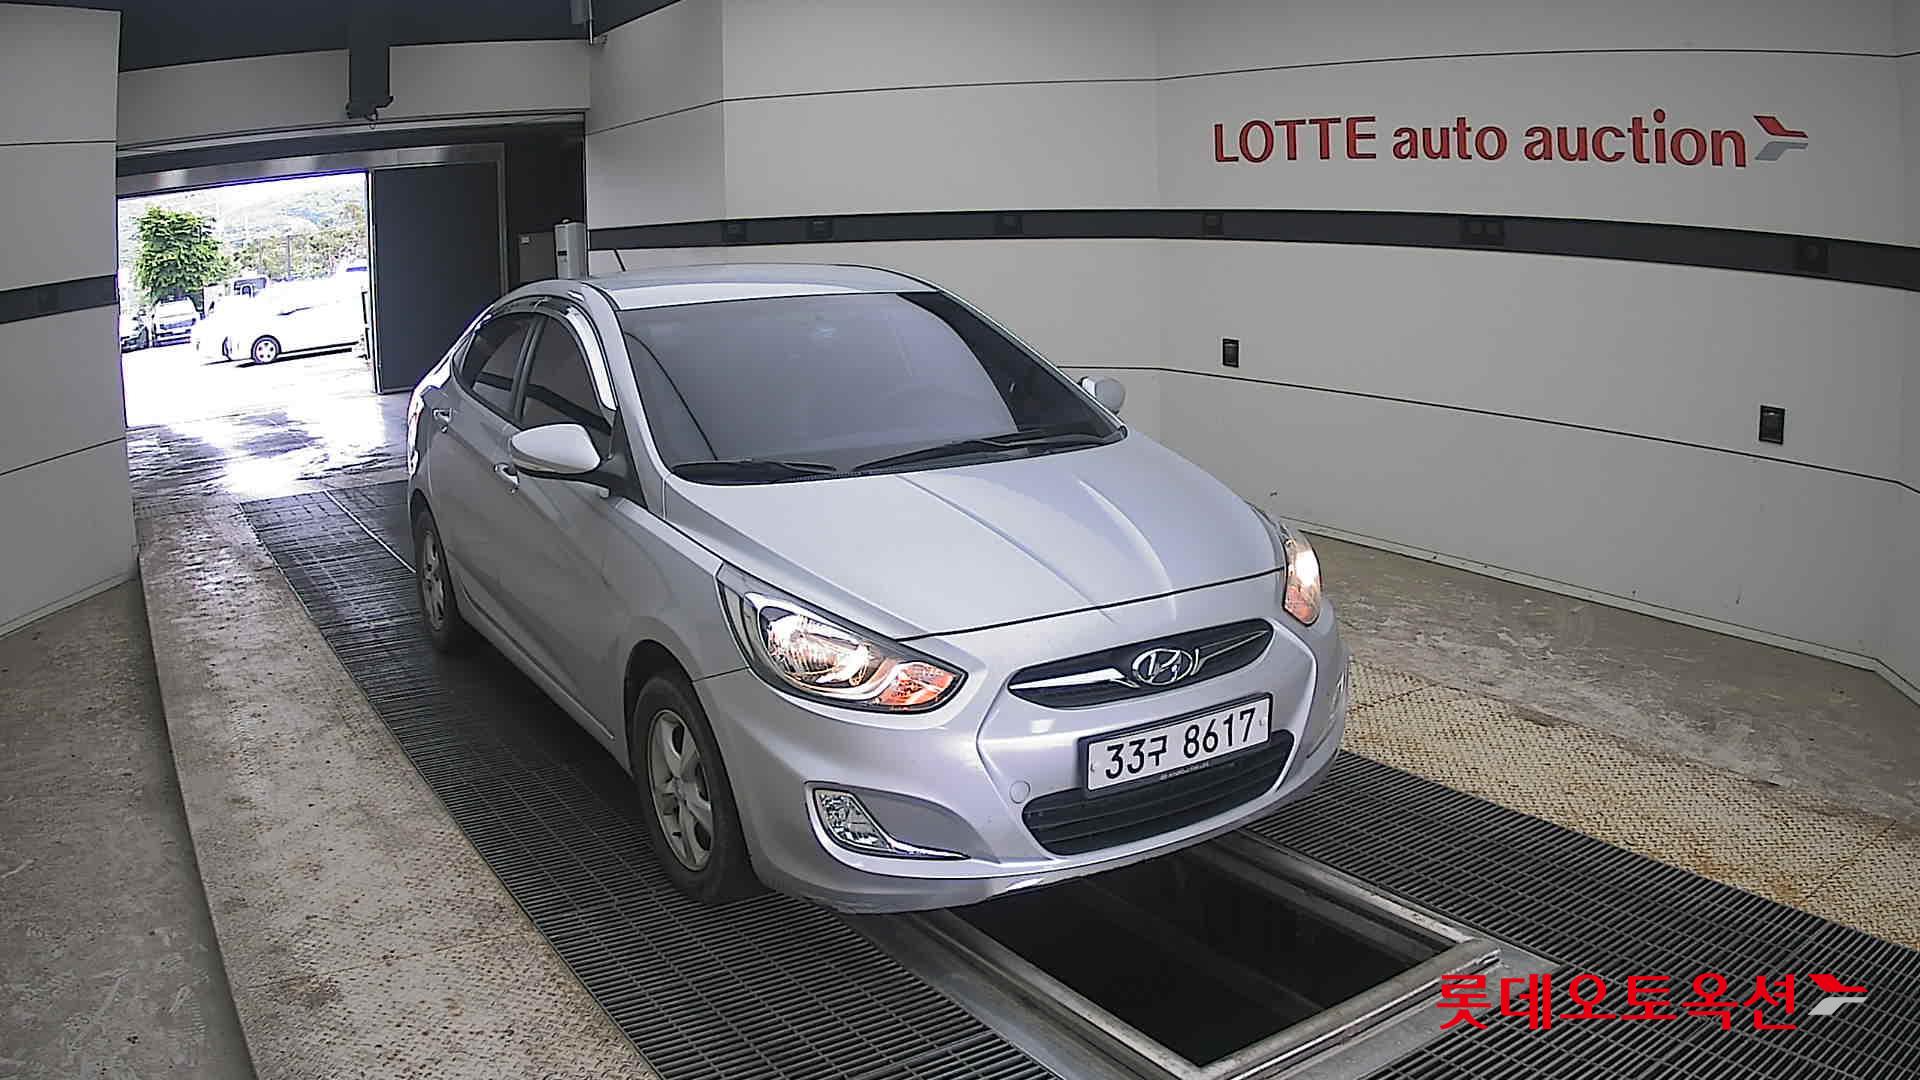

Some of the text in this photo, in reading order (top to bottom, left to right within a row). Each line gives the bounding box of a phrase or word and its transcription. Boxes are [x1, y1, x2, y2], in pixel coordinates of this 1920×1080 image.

[1213, 109, 1747, 168] LOTTE auto auction
[1105, 735, 1168, 780] 33구
[1183, 707, 1256, 759] 8617
